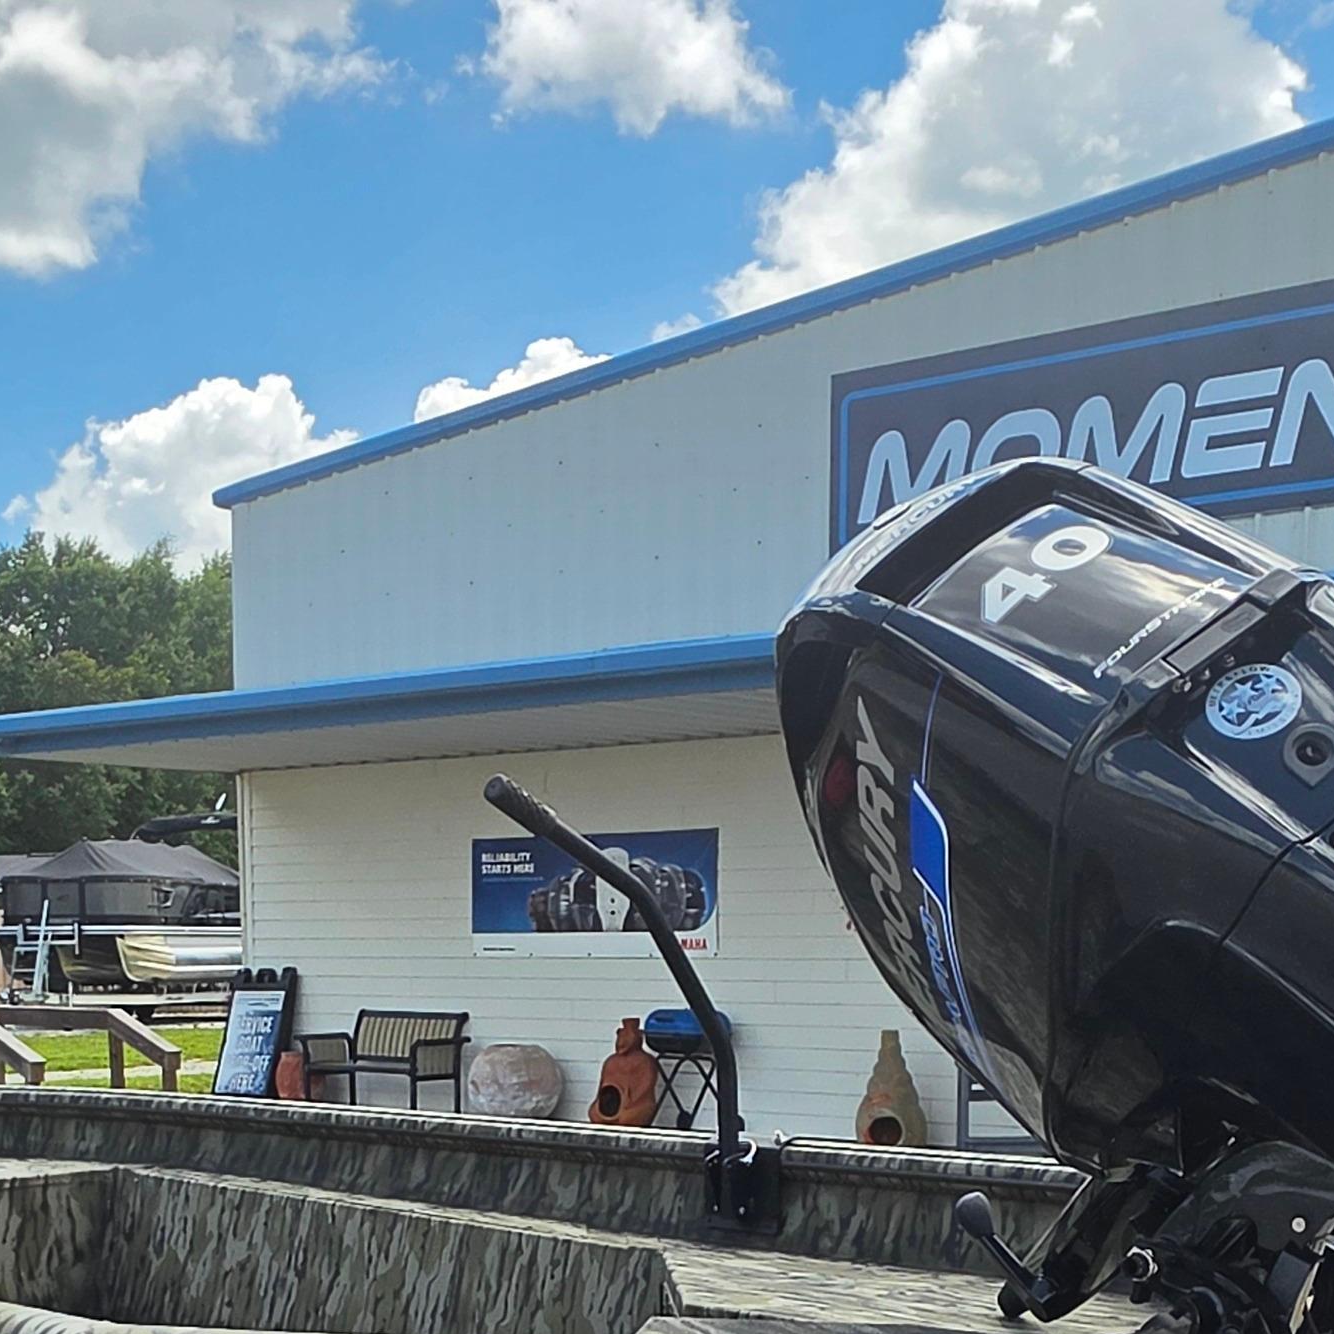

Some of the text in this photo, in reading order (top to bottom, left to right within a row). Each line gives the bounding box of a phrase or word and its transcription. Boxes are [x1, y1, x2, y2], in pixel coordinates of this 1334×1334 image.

[981, 525, 1113, 623] 40
[1093, 577, 1226, 678] FOURSTROKE
[482, 852, 530, 862] RELIABILITY
[482, 863, 534, 874] STARTS HERE
[681, 938, 707, 950] MAHA
